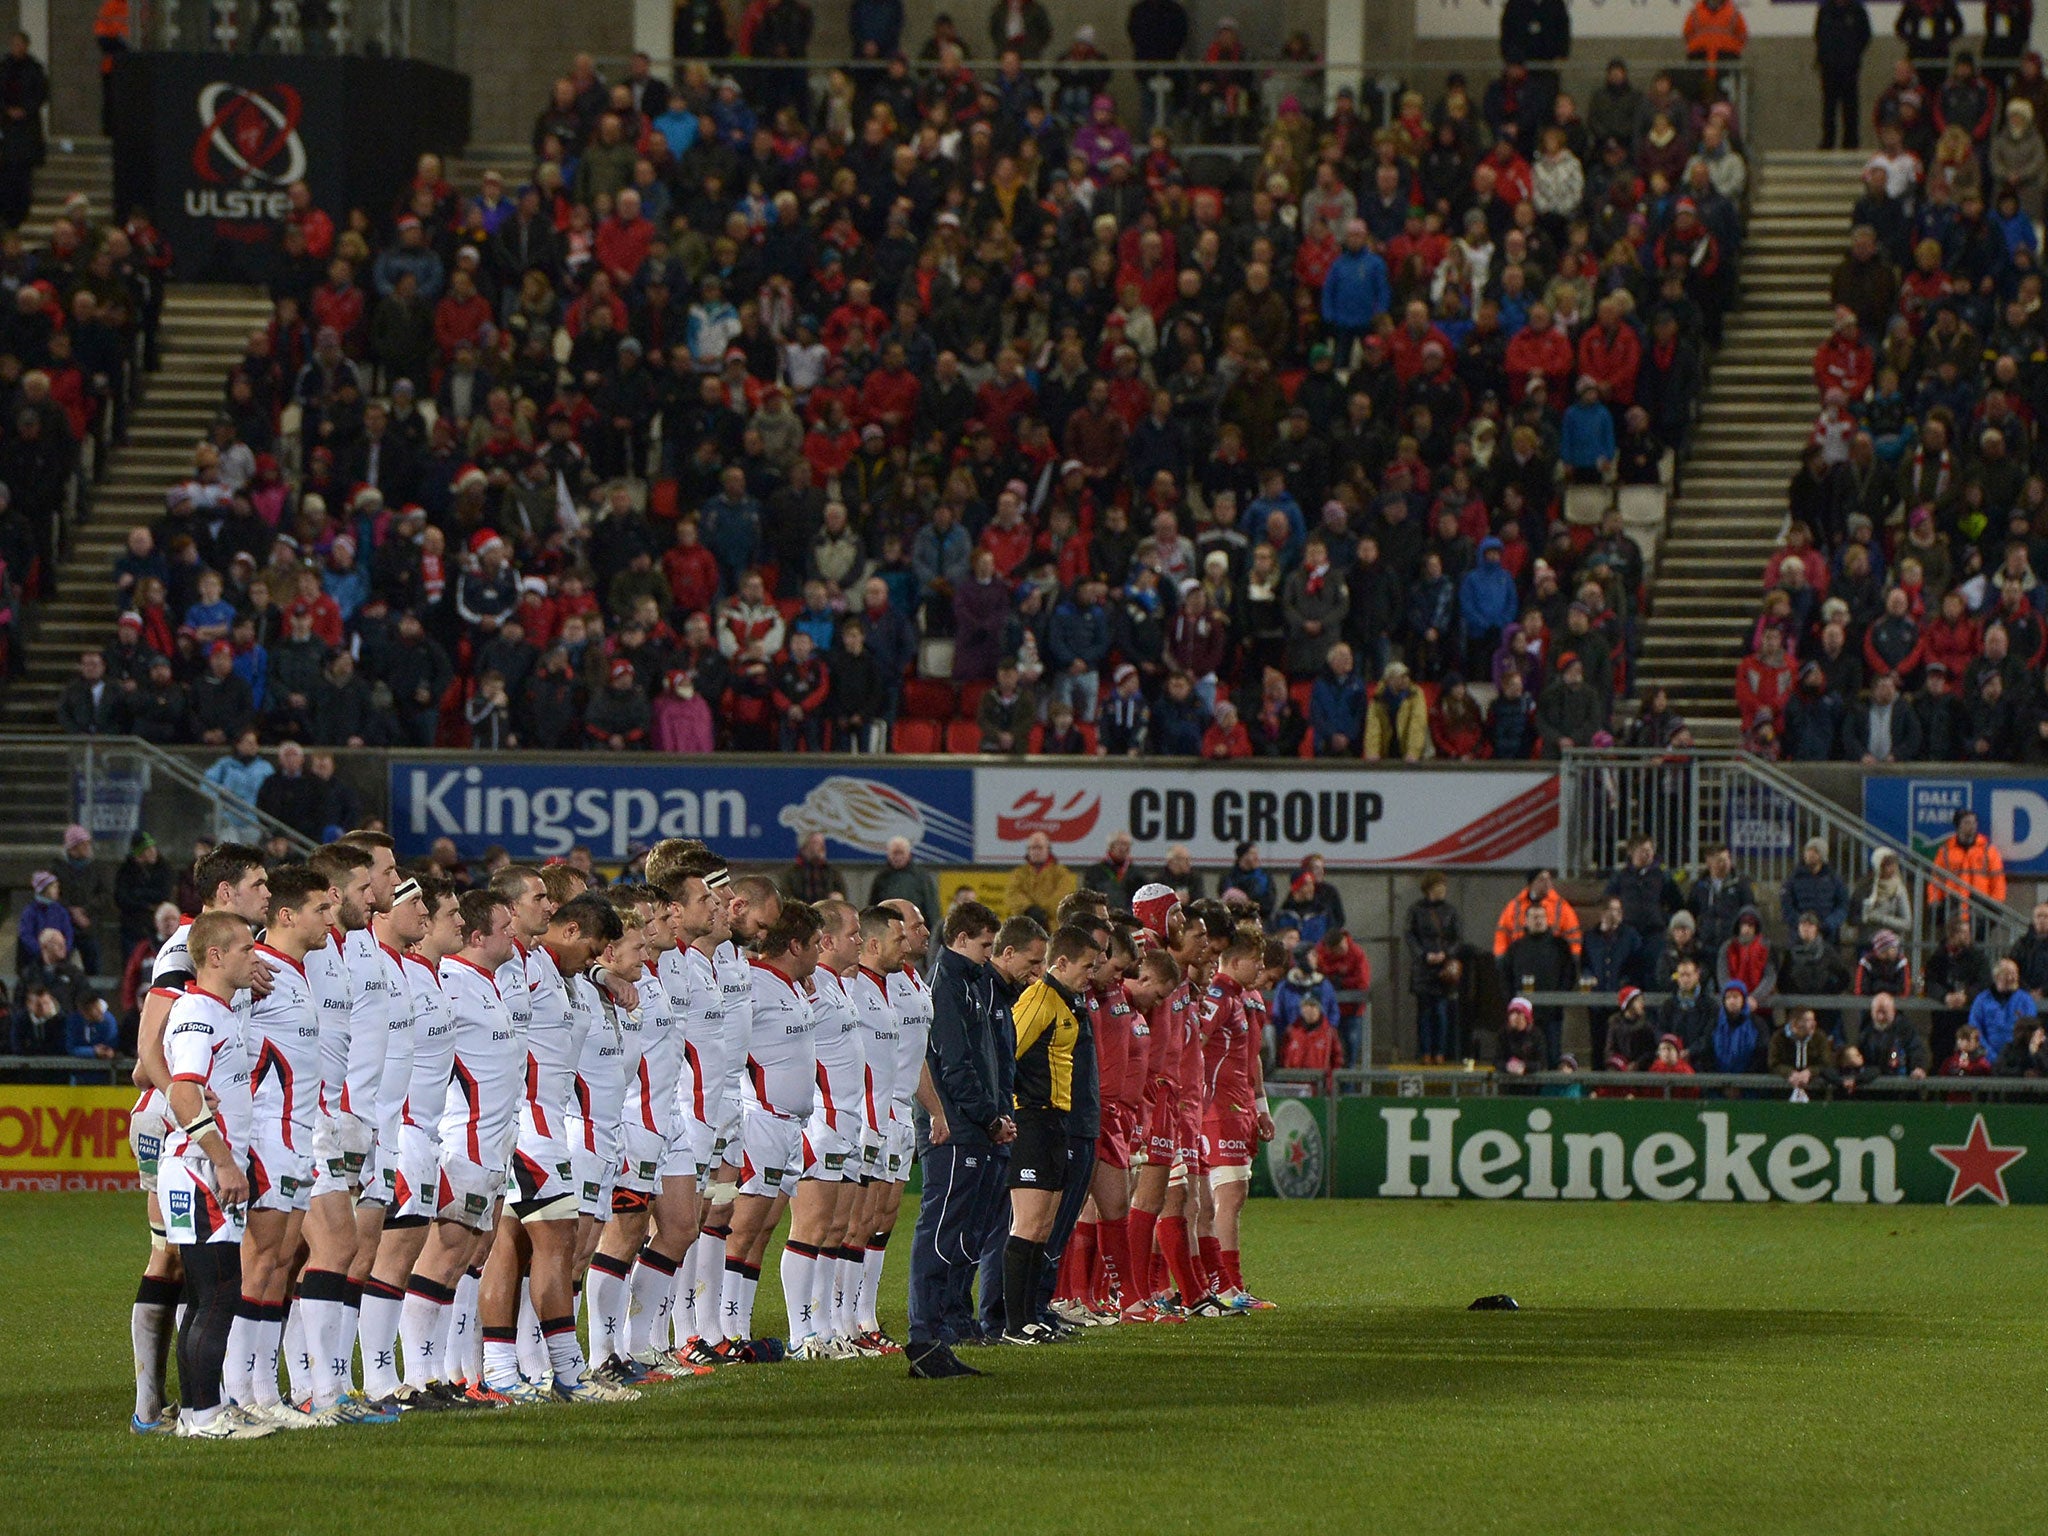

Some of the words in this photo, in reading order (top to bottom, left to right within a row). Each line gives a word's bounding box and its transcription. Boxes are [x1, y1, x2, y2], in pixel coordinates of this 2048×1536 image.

[185, 189, 296, 219] ULSTE
[1917, 790, 1962, 807] DALE
[411, 766, 747, 856] Kingspan
[1129, 788, 1197, 842] CD
[1212, 789, 1384, 843] GROUP
[724, 984, 741, 994] Bank
[323, 999, 345, 1010] Bank
[389, 1018, 408, 1030] Bank
[903, 1016, 921, 1025] Bank
[187, 1022, 211, 1034] Sport
[428, 1022, 448, 1037] Bank
[786, 1024, 804, 1035] Bank
[875, 1030, 892, 1040] Bank
[139, 1136, 158, 1148] DALE
[139, 1145, 158, 1156] FARM
[1379, 1107, 1904, 1205] Heineken
[171, 1193, 189, 1201] DALE
[172, 1201, 189, 1210] FARM
